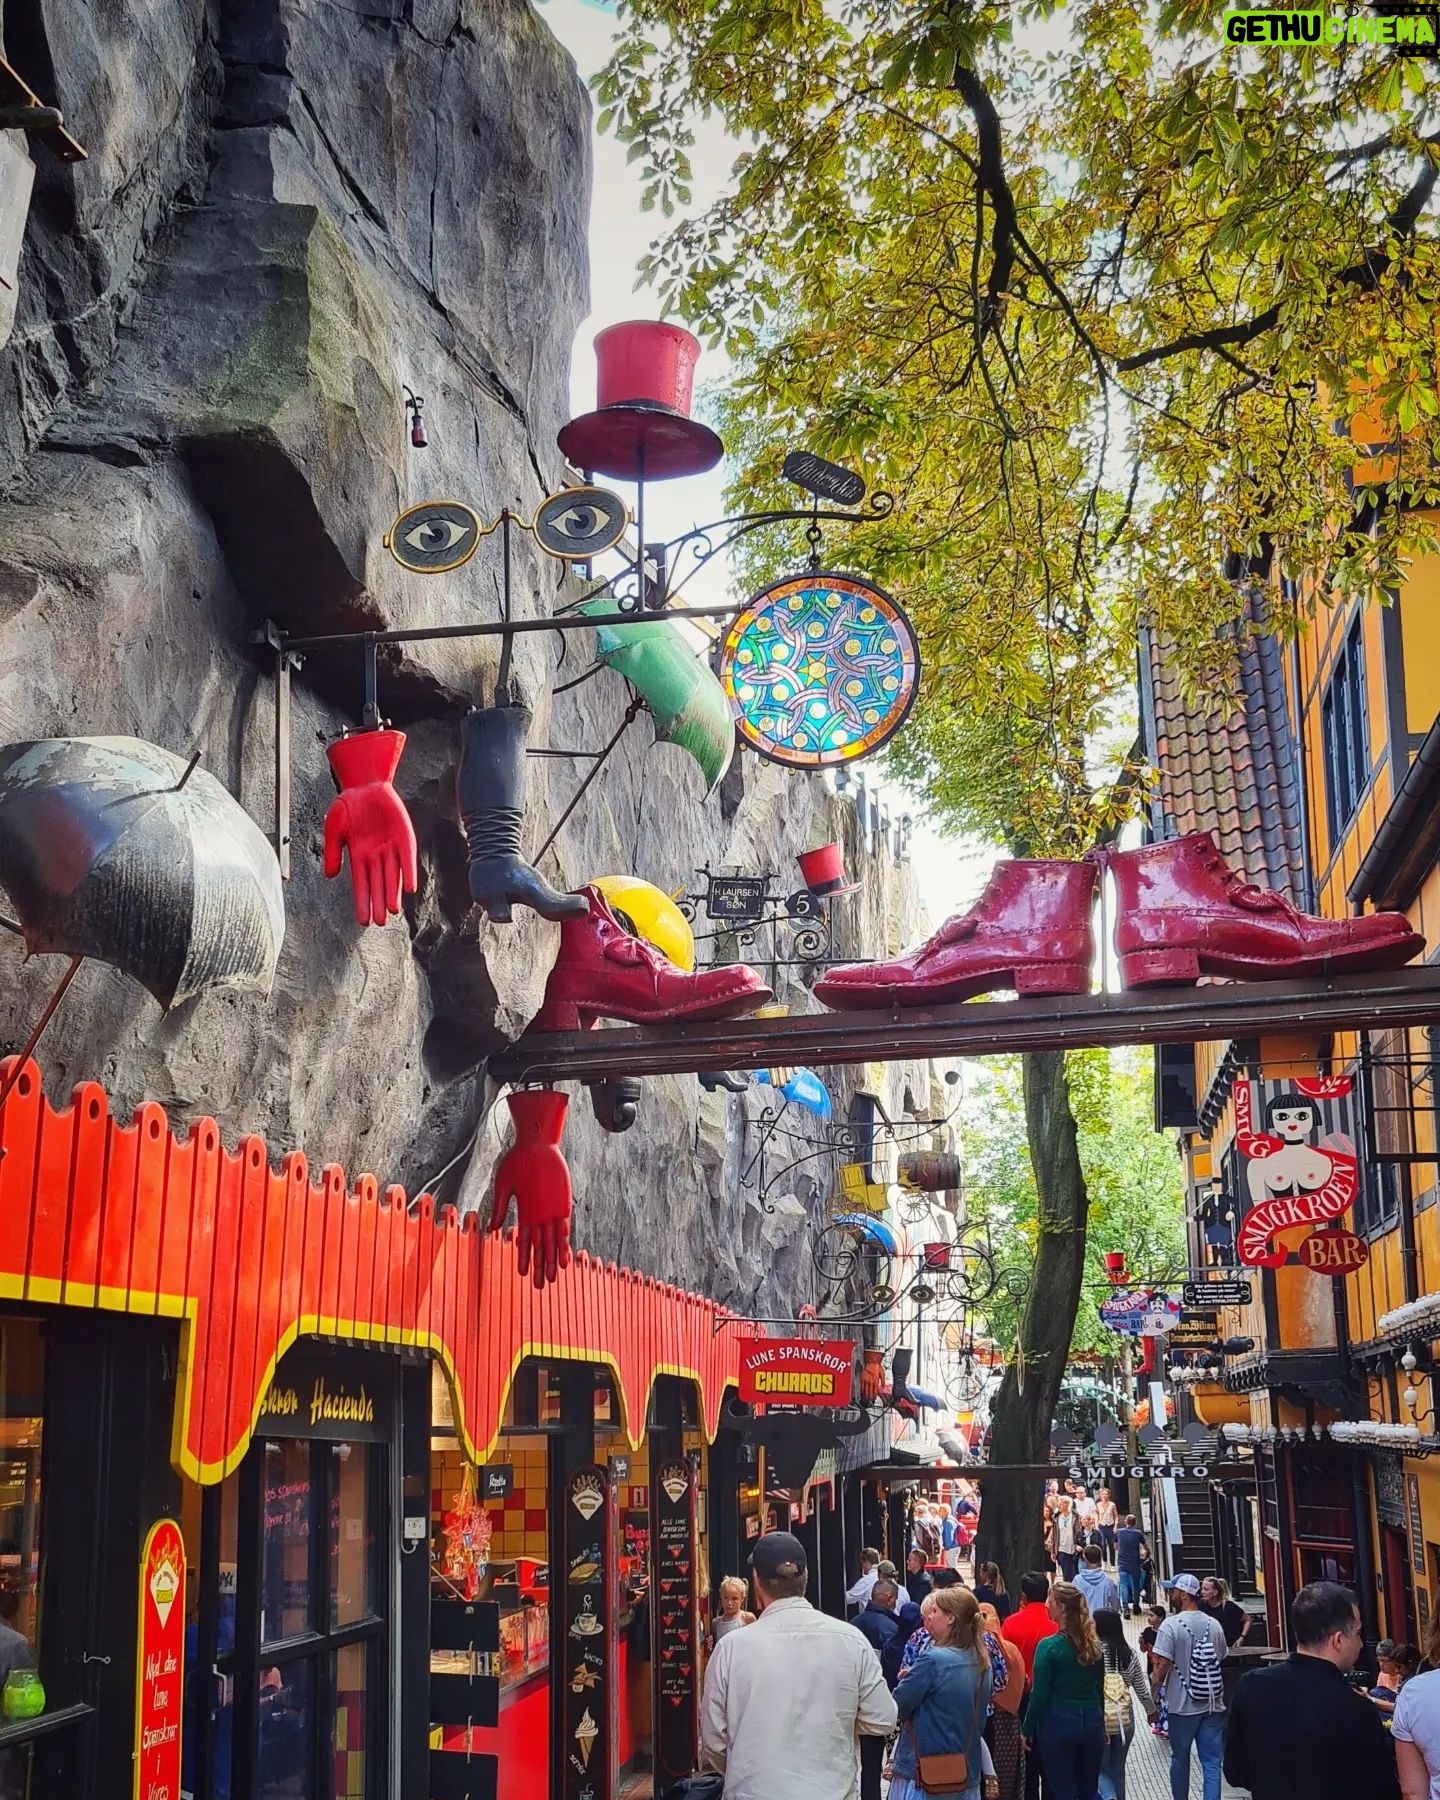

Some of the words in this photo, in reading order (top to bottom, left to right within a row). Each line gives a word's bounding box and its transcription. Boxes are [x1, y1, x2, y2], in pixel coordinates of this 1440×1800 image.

[722, 888, 759, 897] LAURSEN
[796, 894, 810, 914] 5
[726, 901, 747, 909] SØN
[1244, 1157, 1355, 1260] SMUGKROEN
[1307, 1235, 1367, 1267] BAR
[746, 1349, 776, 1369] LUNE
[779, 1346, 847, 1373] SPANSKRØR
[755, 1371, 834, 1395] CHURROS
[309, 1376, 375, 1427] Hacienda
[1068, 1466, 1209, 1479] SMUGKRO
